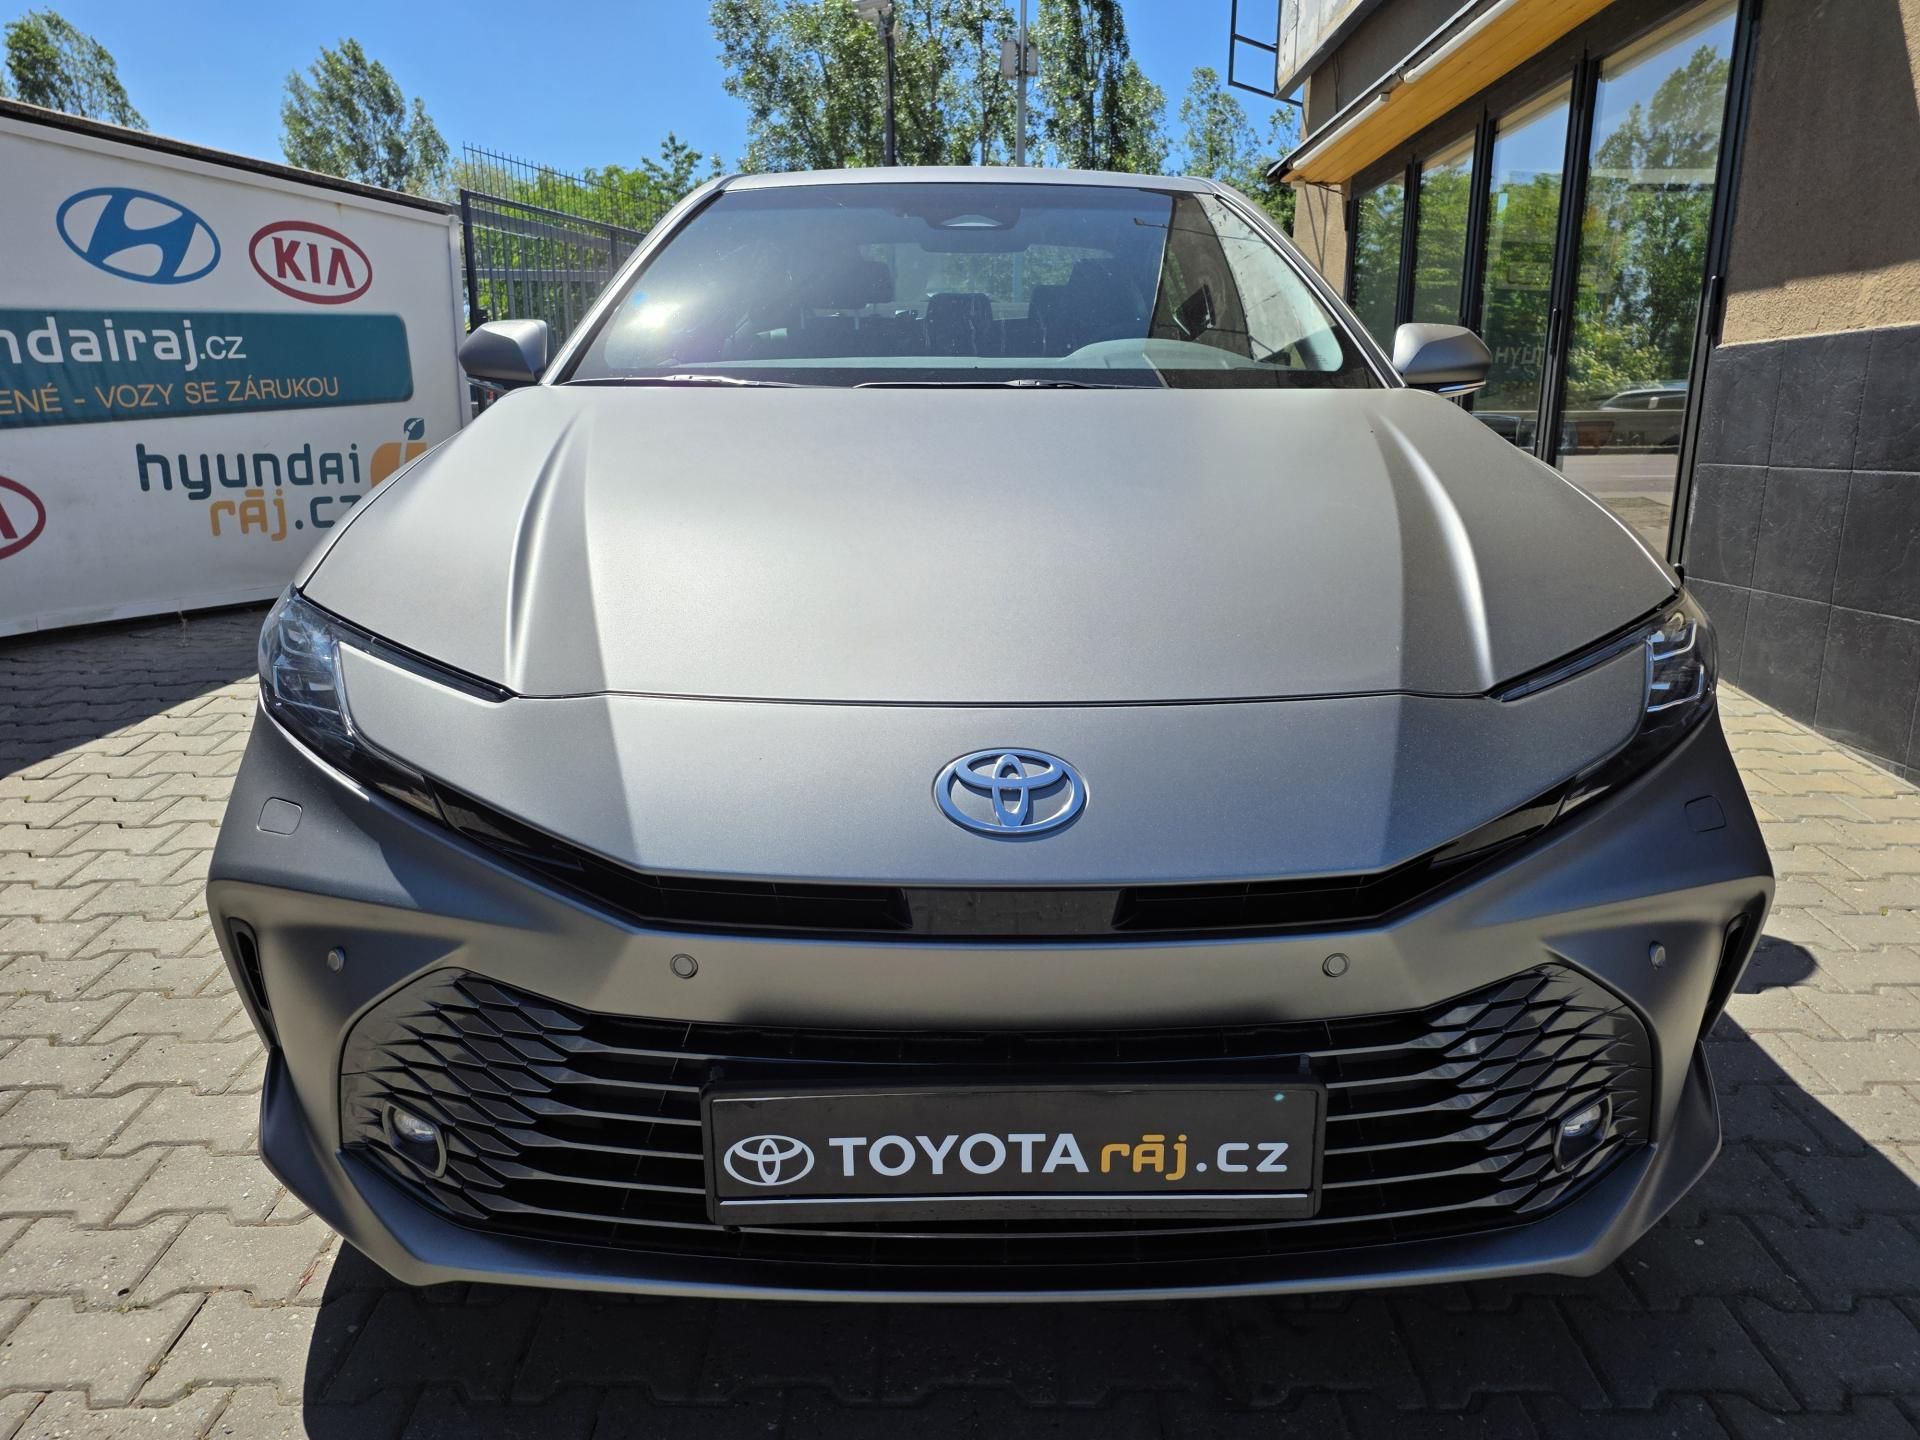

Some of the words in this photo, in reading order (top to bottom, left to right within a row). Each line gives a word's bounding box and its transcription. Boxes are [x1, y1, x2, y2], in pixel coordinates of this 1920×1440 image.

[271, 237, 356, 289] KIA
[95, 384, 174, 408] VOZY
[184, 381, 220, 404] SE
[226, 375, 339, 402] ZÁRUKOU
[828, 1132, 1090, 1177] TOYOTA
